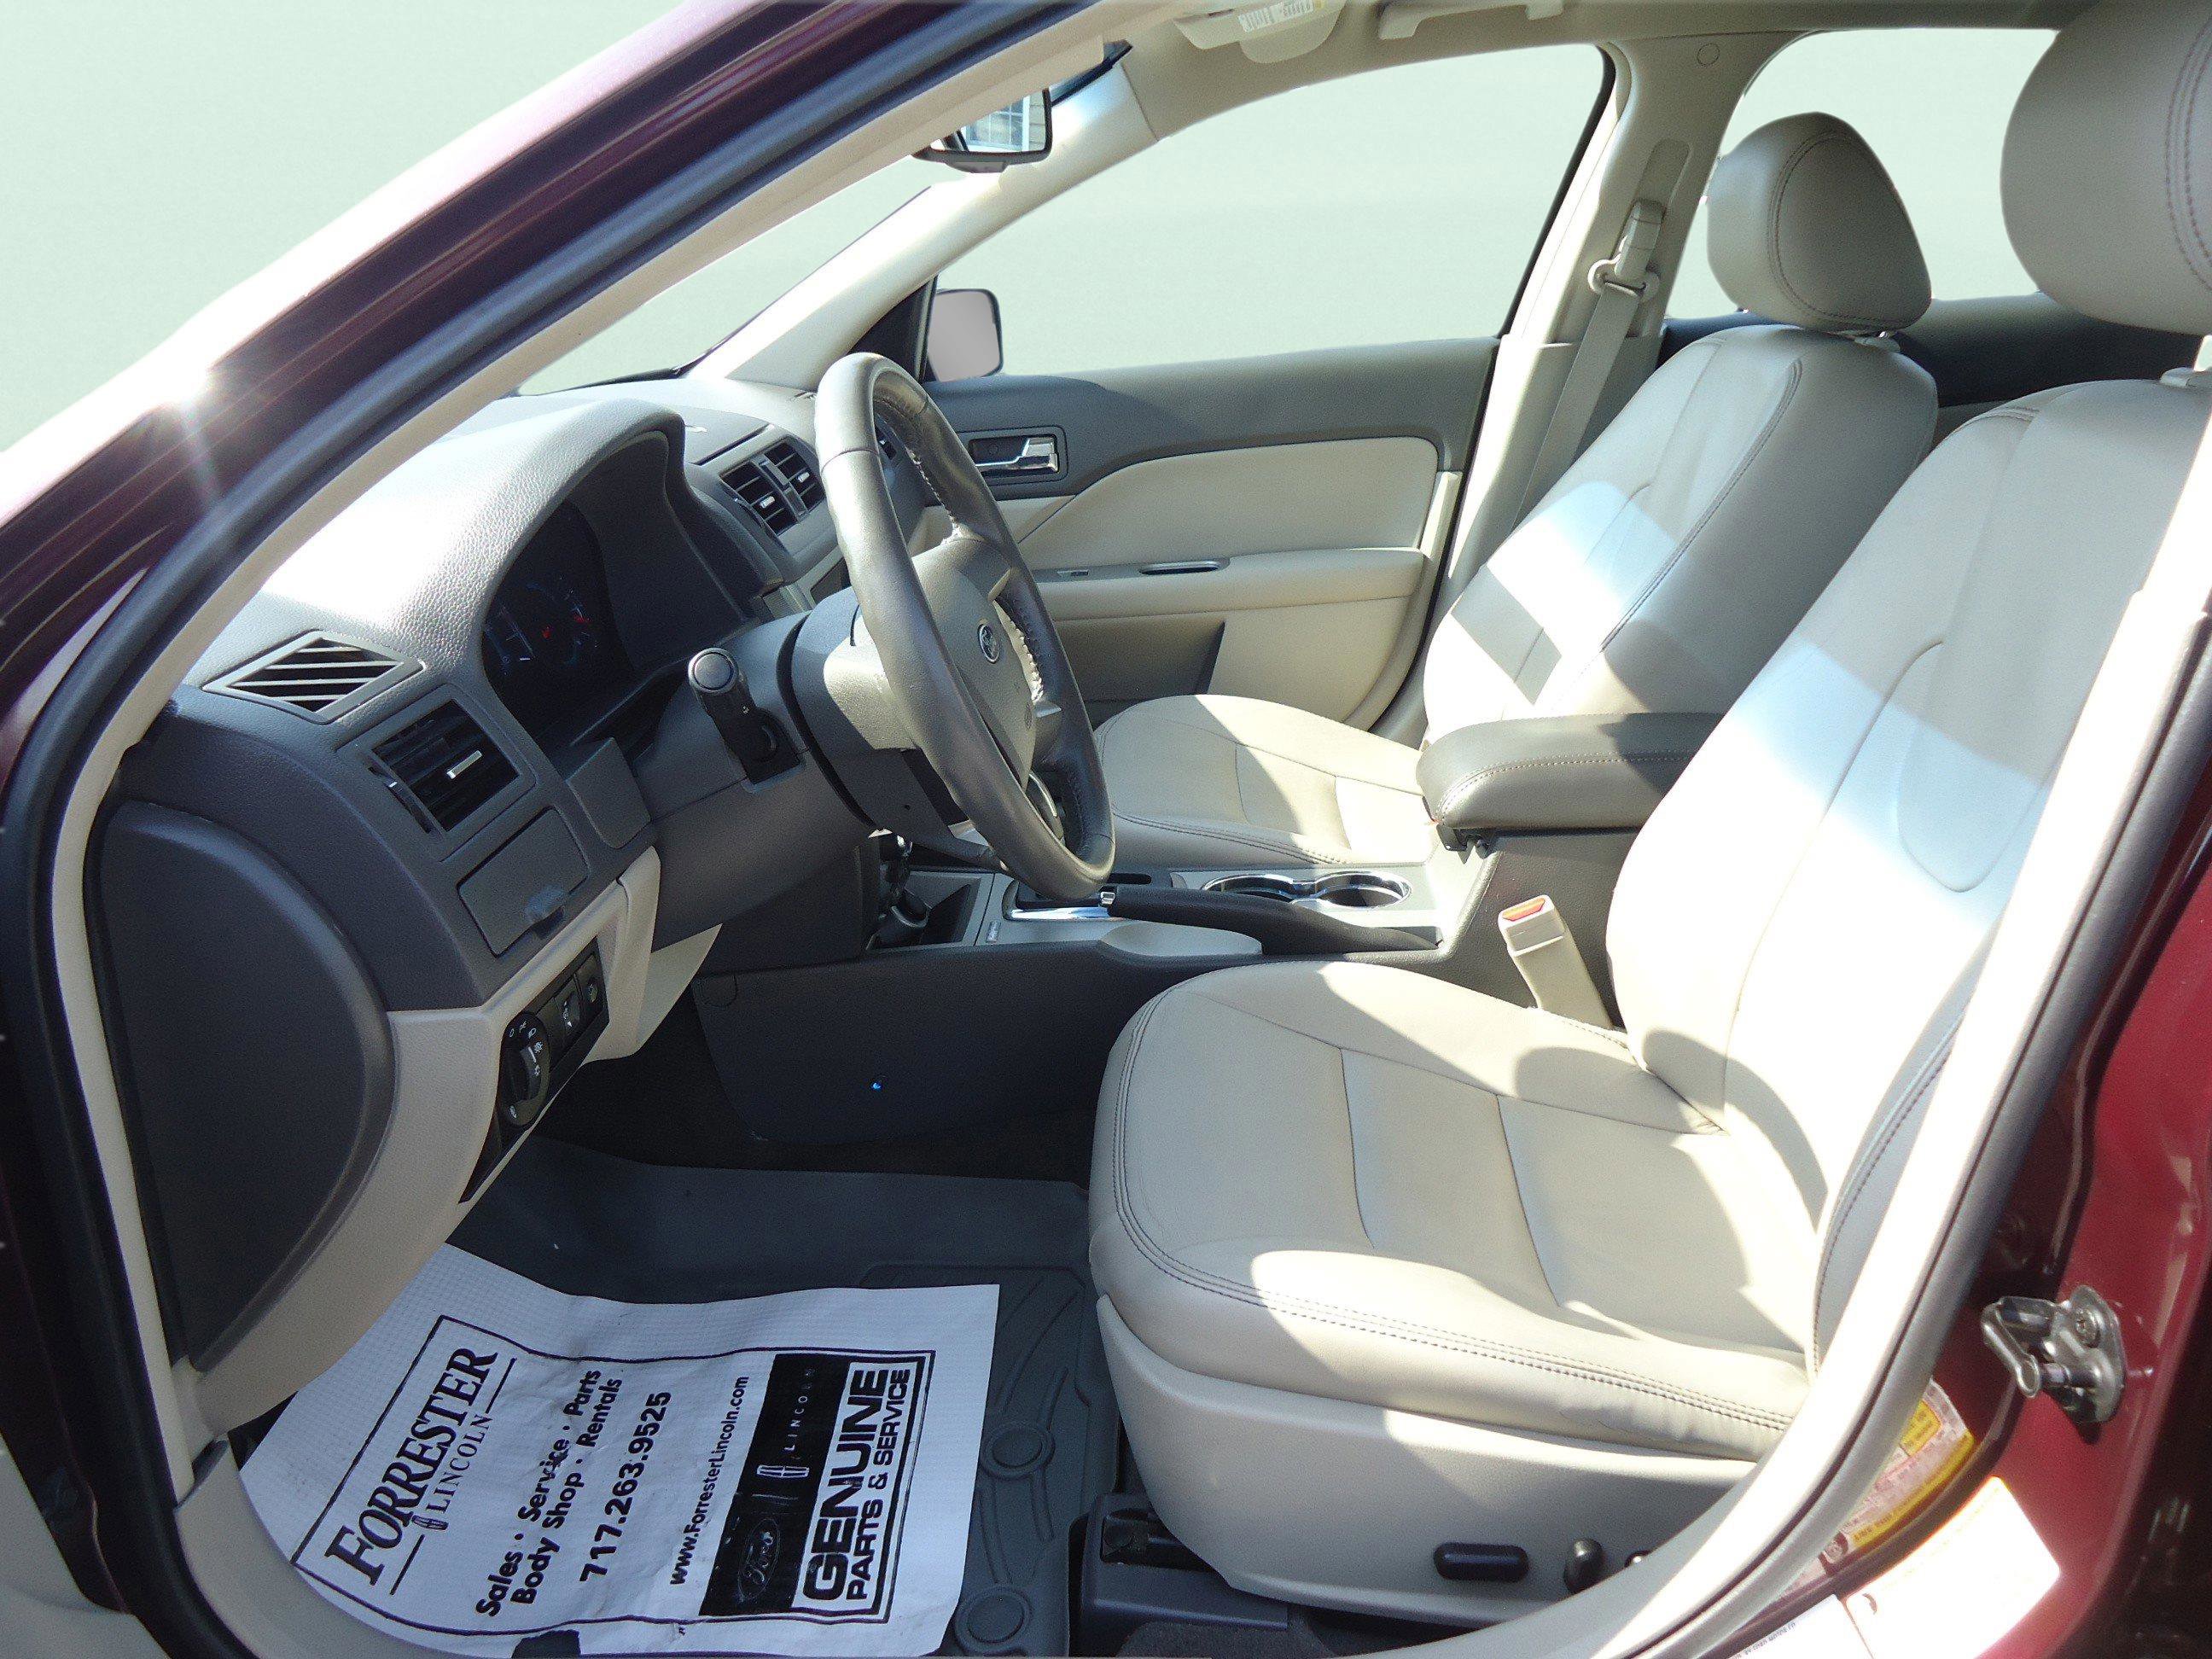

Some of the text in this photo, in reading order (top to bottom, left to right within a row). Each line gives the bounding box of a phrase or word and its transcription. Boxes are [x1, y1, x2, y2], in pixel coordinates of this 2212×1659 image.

[324, 1348, 499, 1586] FORRESTER
[427, 1414, 492, 1513] LINCOLN
[476, 1370, 602, 1616] Sales Service Parts
[510, 1378, 623, 1604] Body Shop Rentals
[580, 1393, 672, 1582] 717.263.9525
[670, 1377, 749, 1585] www.ForresterLincoln.com
[783, 1369, 815, 1452] LINCO
[802, 1369, 889, 1601] GENUINE
[846, 1369, 911, 1600] PARTS & SERVICE
